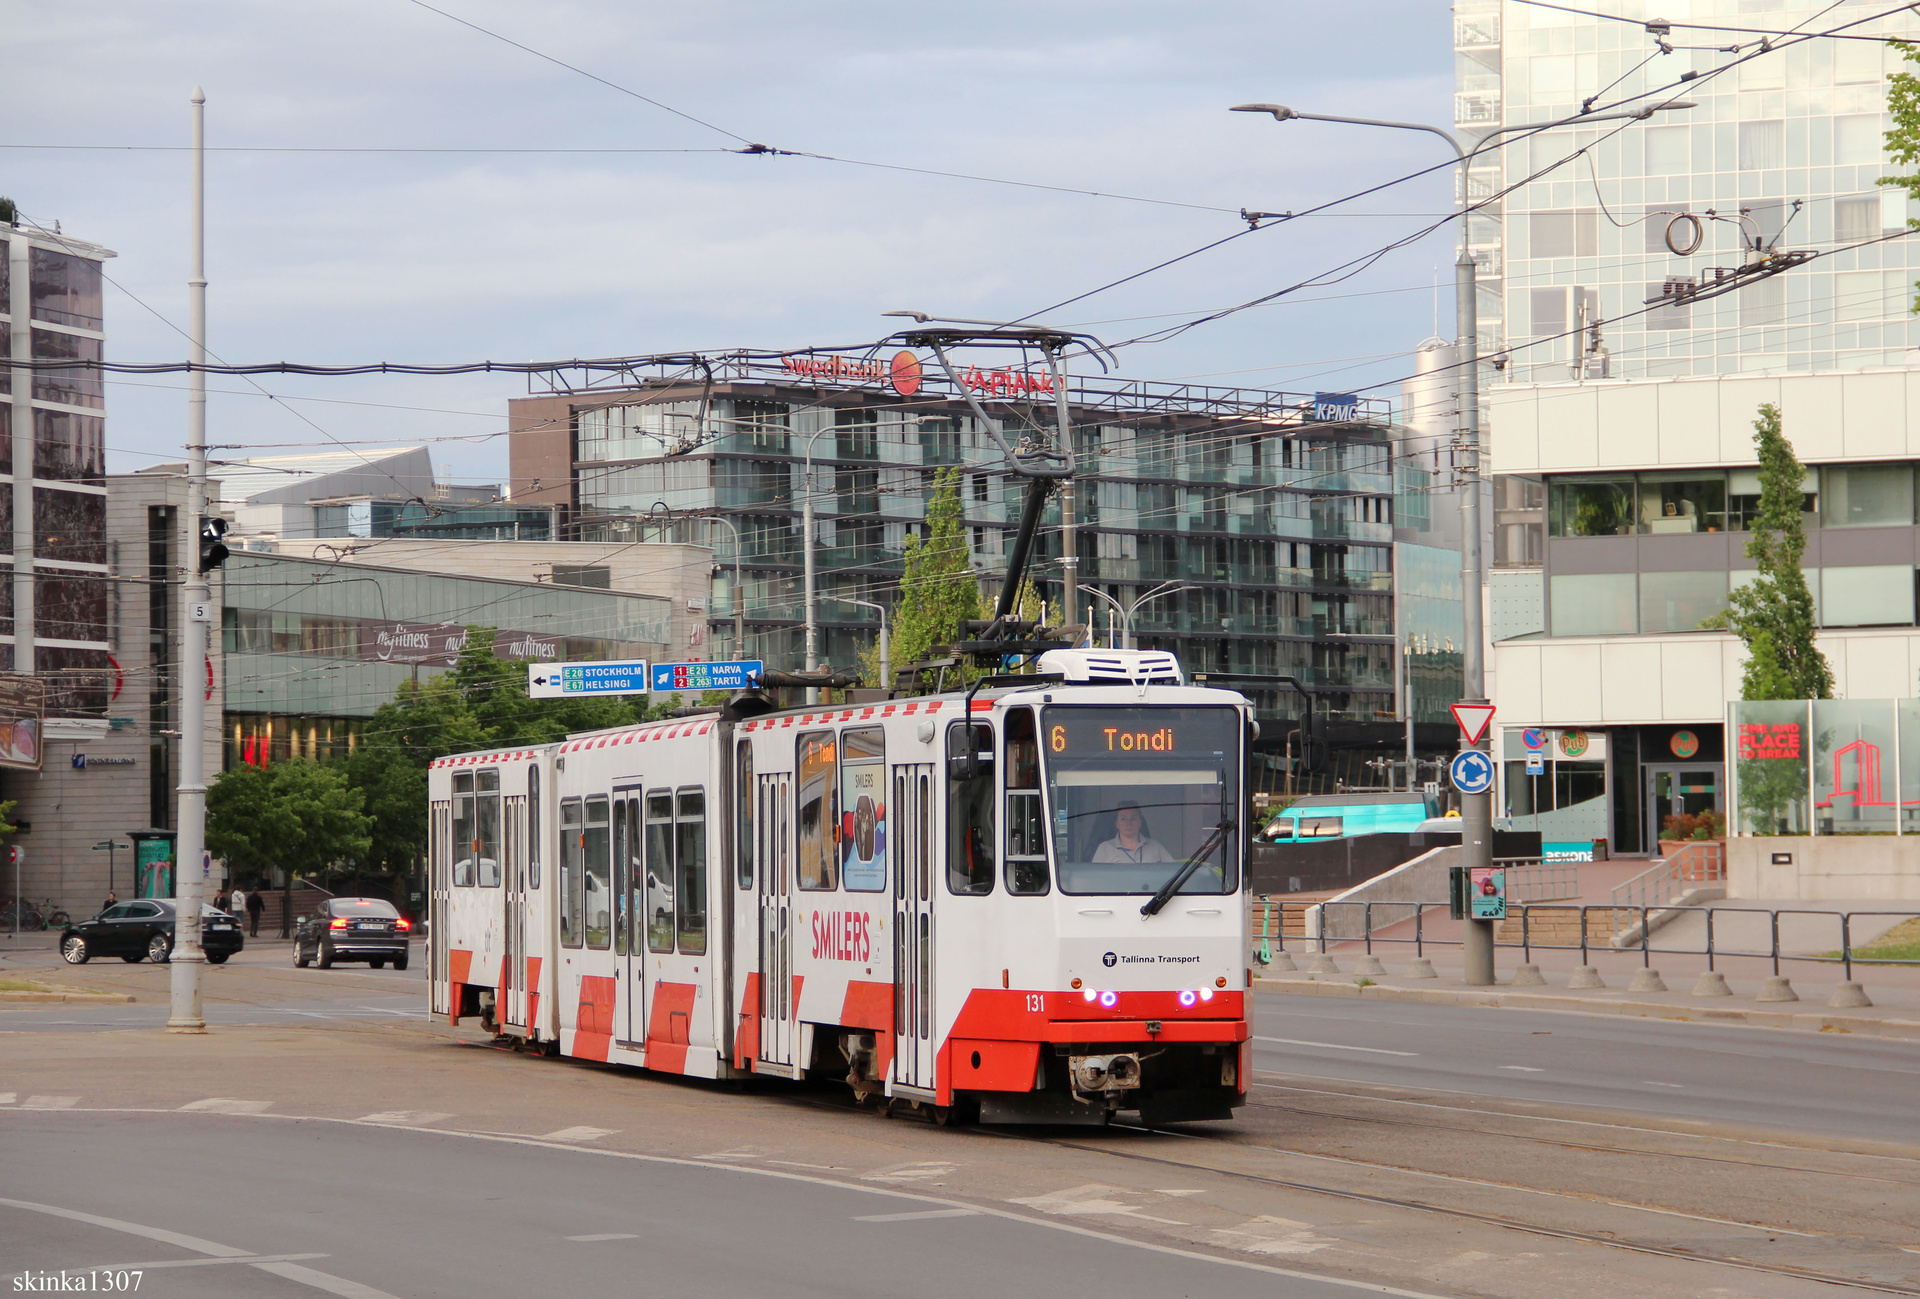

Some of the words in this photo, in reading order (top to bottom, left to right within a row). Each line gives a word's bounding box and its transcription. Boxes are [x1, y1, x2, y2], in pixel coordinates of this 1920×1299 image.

[781, 351, 889, 383] Swedbank
[1317, 403, 1358, 422] KPMG
[196, 606, 204, 617] 5
[509, 634, 555, 661] myfitness
[585, 666, 642, 677] STOCKHOLM
[678, 667, 683, 675] 1
[712, 665, 742, 675] NARVA
[585, 679, 631, 690] HELSINGI
[678, 678, 684, 687] 2
[712, 676, 741, 686] TARTU
[1738, 723, 1768, 734] TIME
[1770, 722, 1800, 734] AND
[1051, 724, 1067, 752] 6
[1103, 728, 1174, 751] Tondi
[1561, 729, 1586, 753] Pub
[1673, 732, 1697, 753] Pub
[1738, 733, 1802, 749] PLACE
[1738, 749, 1756, 759] TO
[1757, 749, 1801, 759] BREAK
[855, 773, 874, 789] SMILERS
[812, 909, 870, 963] SMILERS
[1121, 955, 1155, 964] Tallinna
[1158, 955, 1201, 965] Transport
[1025, 993, 1045, 1013] 131
